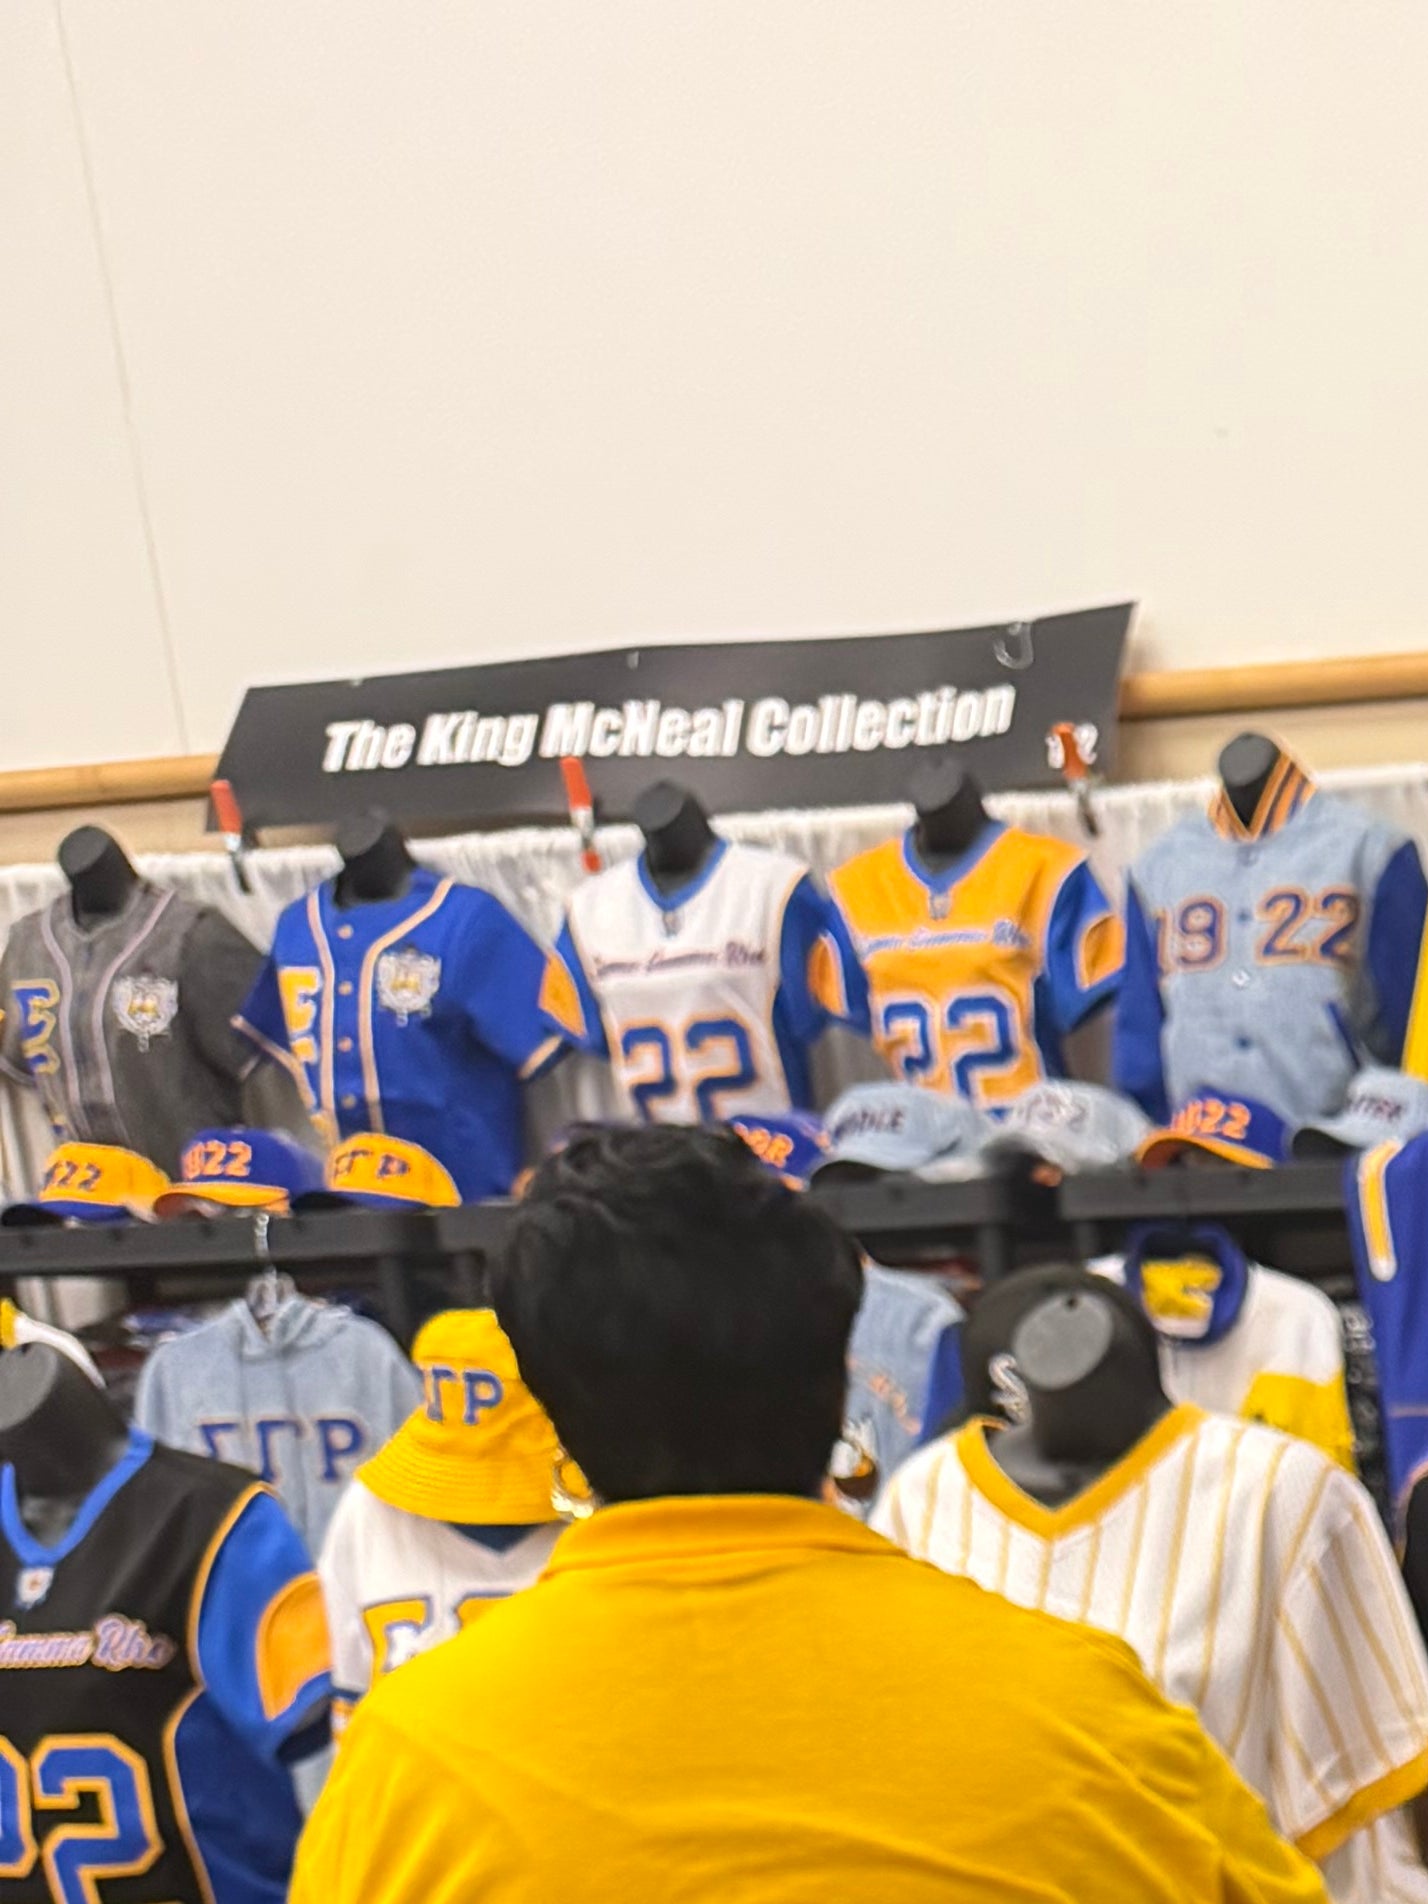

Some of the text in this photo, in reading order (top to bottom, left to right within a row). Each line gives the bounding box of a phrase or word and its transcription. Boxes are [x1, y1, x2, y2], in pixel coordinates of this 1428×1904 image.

[322, 719, 416, 772] The
[416, 710, 539, 767] King
[538, 699, 745, 758] McNeal
[745, 683, 1016, 757] Collection
[1252, 884, 1362, 968] 22
[616, 1010, 762, 1124] 22
[880, 988, 1021, 1118] 22
